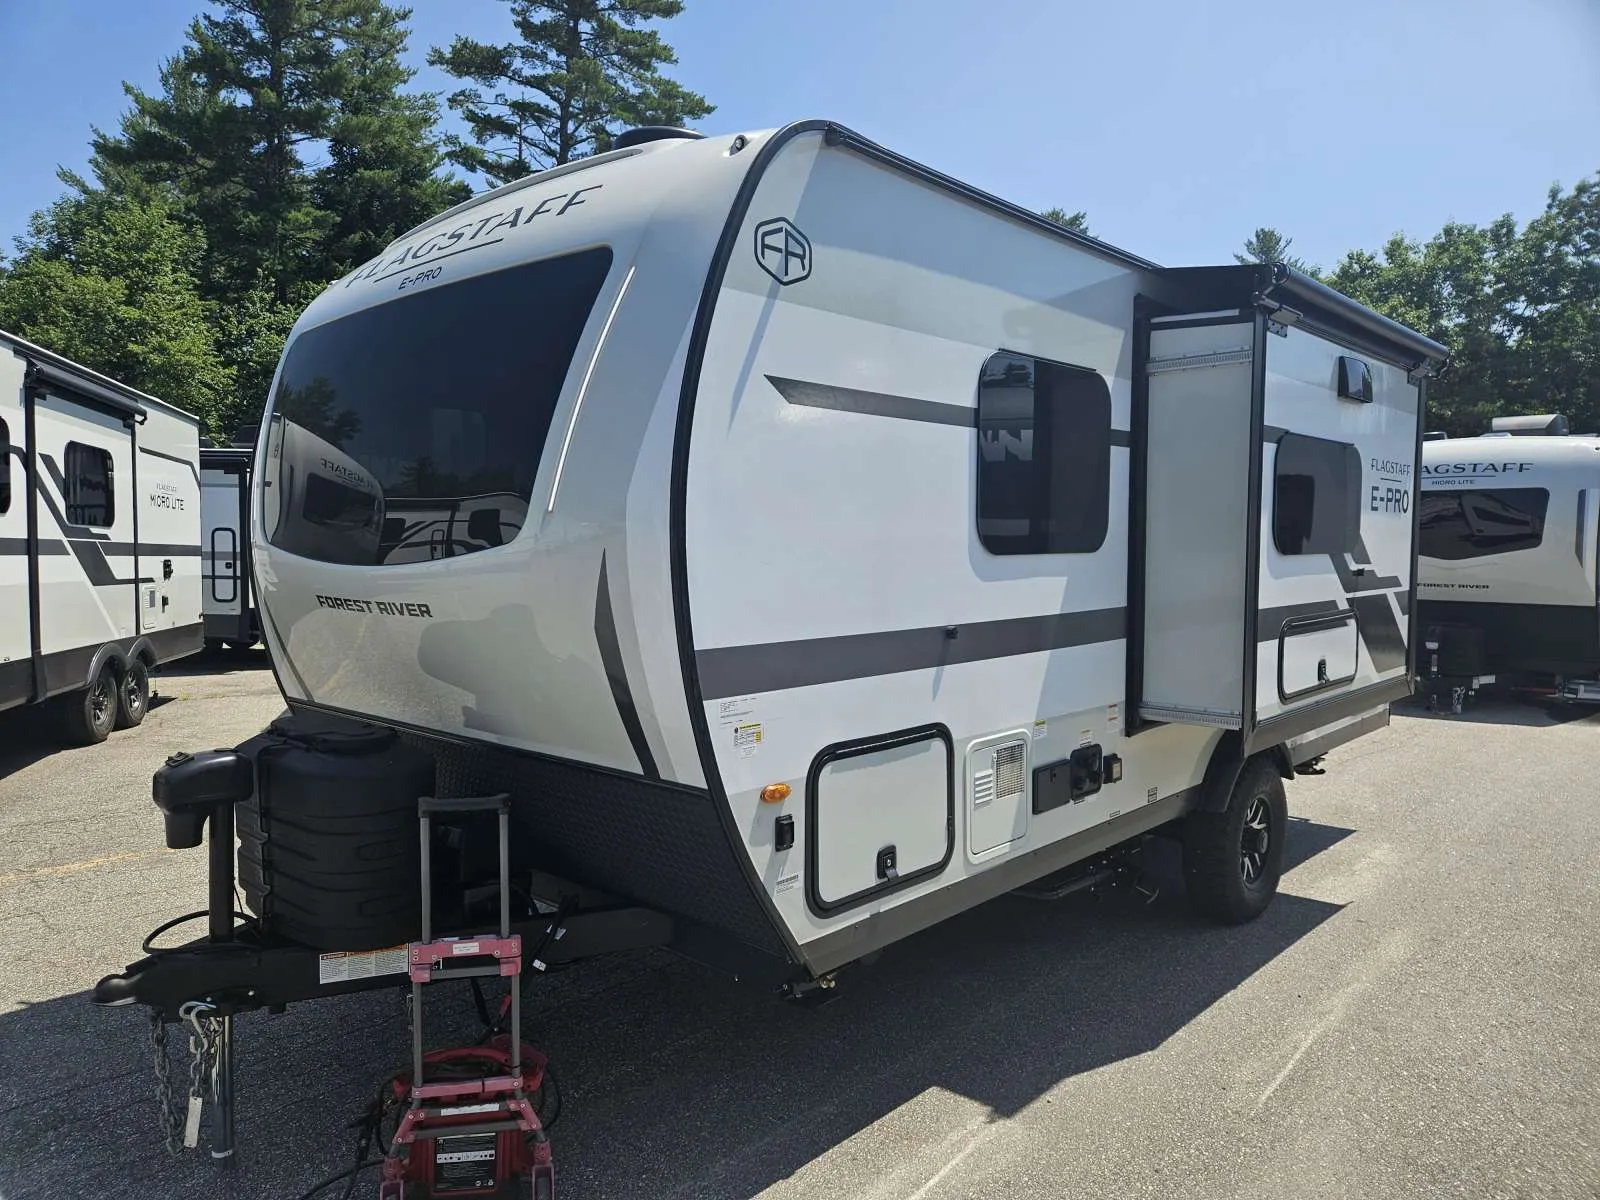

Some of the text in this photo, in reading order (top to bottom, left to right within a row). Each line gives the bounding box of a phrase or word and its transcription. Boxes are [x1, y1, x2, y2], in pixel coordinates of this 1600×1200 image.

[346, 184, 603, 288] FLAGSTAFF
[398, 266, 443, 290] E-PRO
[1370, 458, 1411, 476] FLAGSTAFF
[1421, 463, 1534, 475] AGSTAFF
[151, 494, 185, 511] MICRO LITE
[1370, 486, 1409, 513] E-PRO
[315, 594, 433, 618] FOREST RIVER
